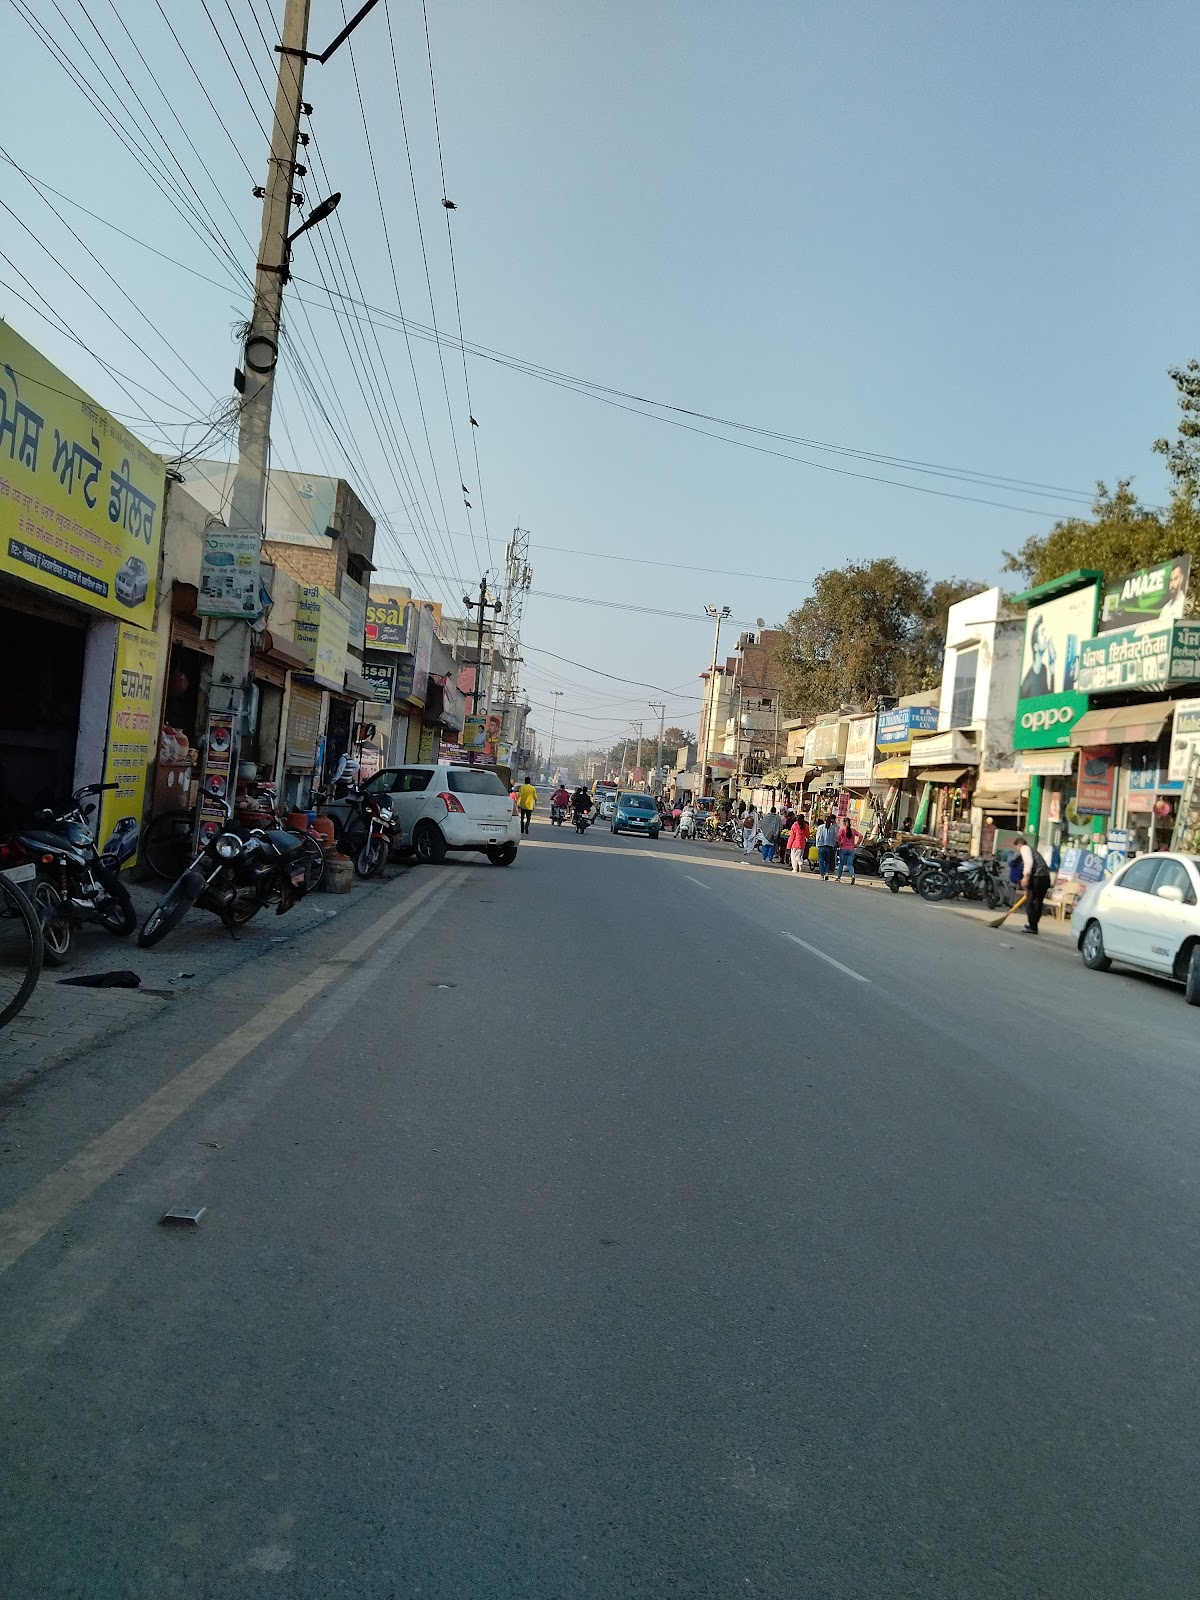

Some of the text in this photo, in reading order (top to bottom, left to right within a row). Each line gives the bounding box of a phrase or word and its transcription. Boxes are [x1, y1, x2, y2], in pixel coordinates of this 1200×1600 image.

[109, 458, 156, 545] ਡੀਲਰ
[1120, 569, 1166, 601] AMAZE
[1083, 646, 1106, 668] ਪੰਜਾਬ
[1021, 706, 1074, 732] oppo
